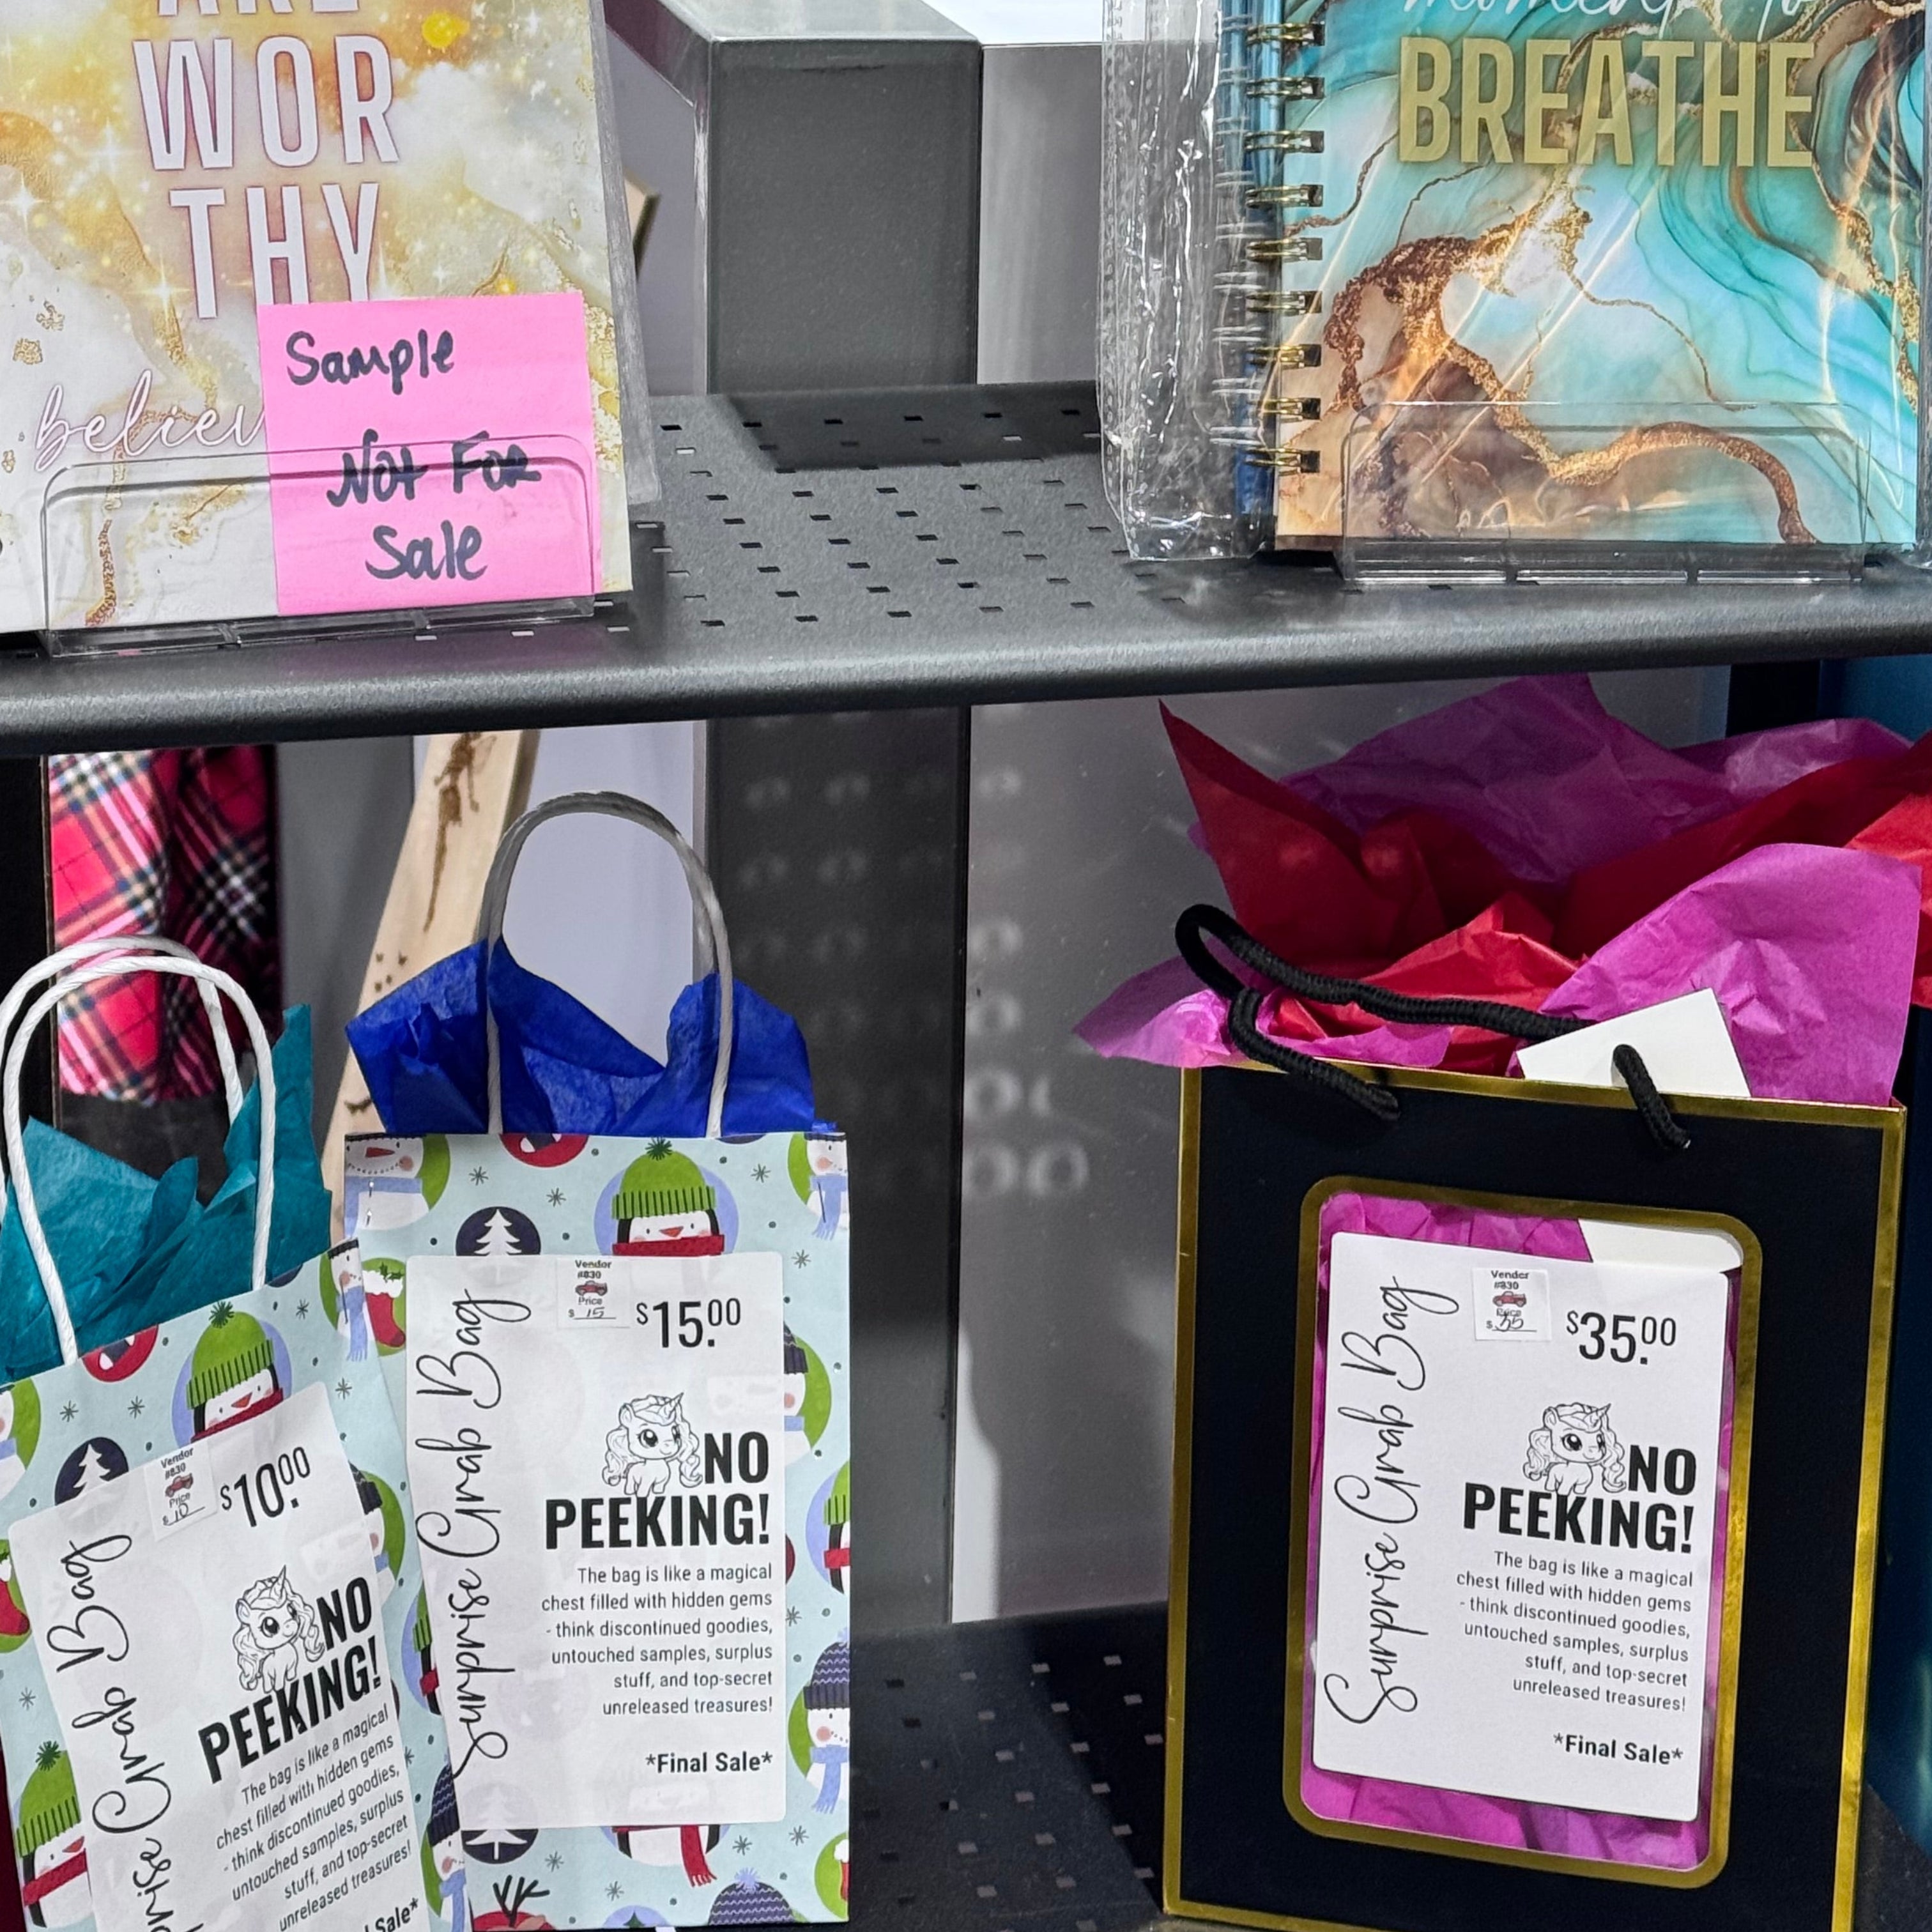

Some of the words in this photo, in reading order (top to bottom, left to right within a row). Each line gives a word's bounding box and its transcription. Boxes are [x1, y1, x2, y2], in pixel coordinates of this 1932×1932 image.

[132, 34, 399, 171] WOR
[1399, 36, 1816, 168] BREATHE
[169, 182, 379, 318] THY
[286, 328, 454, 395] Sample
[326, 428, 429, 507] Not
[365, 520, 487, 580] Sale
[575, 1260, 611, 1269] Vendor
[578, 1296, 602, 1306] Price
[1340, 1275, 1459, 1391] Bag
[415, 1288, 531, 1409] Bag
[161, 1448, 194, 1468] Vendor
[703, 1431, 768, 1483] NO
[1335, 1404, 1422, 1524] Grab
[1628, 1445, 1696, 1496] NO
[169, 1492, 190, 1508] Price
[415, 1427, 501, 1559] Grab
[546, 1493, 770, 1550] PEEKING!
[1463, 1483, 1694, 1553] PEEKING!
[542, 1595, 585, 1611] chest
[590, 1593, 629, 1610] filled
[634, 1593, 666, 1609] with
[671, 1591, 724, 1609] hidden
[729, 1593, 772, 1610] gems
[578, 1567, 606, 1584] The
[612, 1566, 640, 1586] bag
[646, 1566, 659, 1582] is
[664, 1565, 691, 1581] like
[696, 1567, 705, 1581] a
[710, 1563, 772, 1583] magical
[1456, 1570, 1499, 1590] chest
[1506, 1576, 1544, 1595] filled
[1549, 1583, 1583, 1600] with
[1588, 1586, 1641, 1607] hidden
[1647, 1595, 1691, 1613] gems
[1494, 1551, 1522, 1568] The
[1528, 1554, 1557, 1575] bag
[1563, 1558, 1575, 1575] is
[1581, 1561, 1609, 1579] like
[1614, 1567, 1623, 1580] a
[1629, 1568, 1693, 1588] magical
[47, 1535, 132, 1673] Bag
[316, 1577, 372, 1650] NO
[556, 1620, 594, 1638] think
[600, 1618, 700, 1637] discontinued
[706, 1616, 773, 1637] goodies,
[1324, 1531, 1429, 1724] Surprise
[1469, 1597, 1508, 1616] think
[1514, 1602, 1616, 1629] discontinued
[1622, 1618, 1690, 1639] goodies,
[551, 1645, 634, 1664] untouched
[640, 1644, 710, 1665] samples,
[715, 1643, 772, 1664] surplus
[1464, 1623, 1547, 1646] untouched
[1552, 1633, 1624, 1657] samples,
[1629, 1644, 1689, 1663] surplus
[1525, 1655, 1566, 1675] stuff,
[1572, 1660, 1601, 1676] and
[1606, 1664, 1687, 1687] top-secret
[198, 1635, 381, 1784] PEEKING!
[602, 1698, 689, 1715] unreleased
[694, 1696, 772, 1714] treasures!
[614, 1671, 655, 1689] stuff,
[660, 1671, 688, 1687] and
[694, 1671, 772, 1689] top-secret
[1513, 1678, 1600, 1701] unreleased
[1606, 1689, 1686, 1712] treasures!
[72, 1687, 171, 1834] Grab
[241, 1782, 267, 1805] The
[269, 1766, 291, 1790] bag
[295, 1758, 306, 1775] is
[308, 1746, 329, 1767] like
[332, 1736, 340, 1749] a
[342, 1702, 388, 1745] magical
[217, 1818, 254, 1850] chest
[256, 1796, 287, 1828] filled
[288, 1781, 316, 1807] with
[317, 1759, 358, 1792] hidden
[361, 1734, 395, 1760] gems
[231, 1841, 264, 1872] think
[267, 1793, 346, 1851] discontinued
[348, 1763, 400, 1807] goodies,
[232, 1851, 299, 1901] untouched
[302, 1817, 358, 1860] samples,
[360, 1789, 404, 1826] surplus
[284, 1867, 319, 1899] stuff,
[321, 1852, 345, 1878] and
[347, 1814, 409, 1863] top-secret
[279, 1881, 349, 1932] unreleased
[351, 1839, 412, 1890] treasures!
